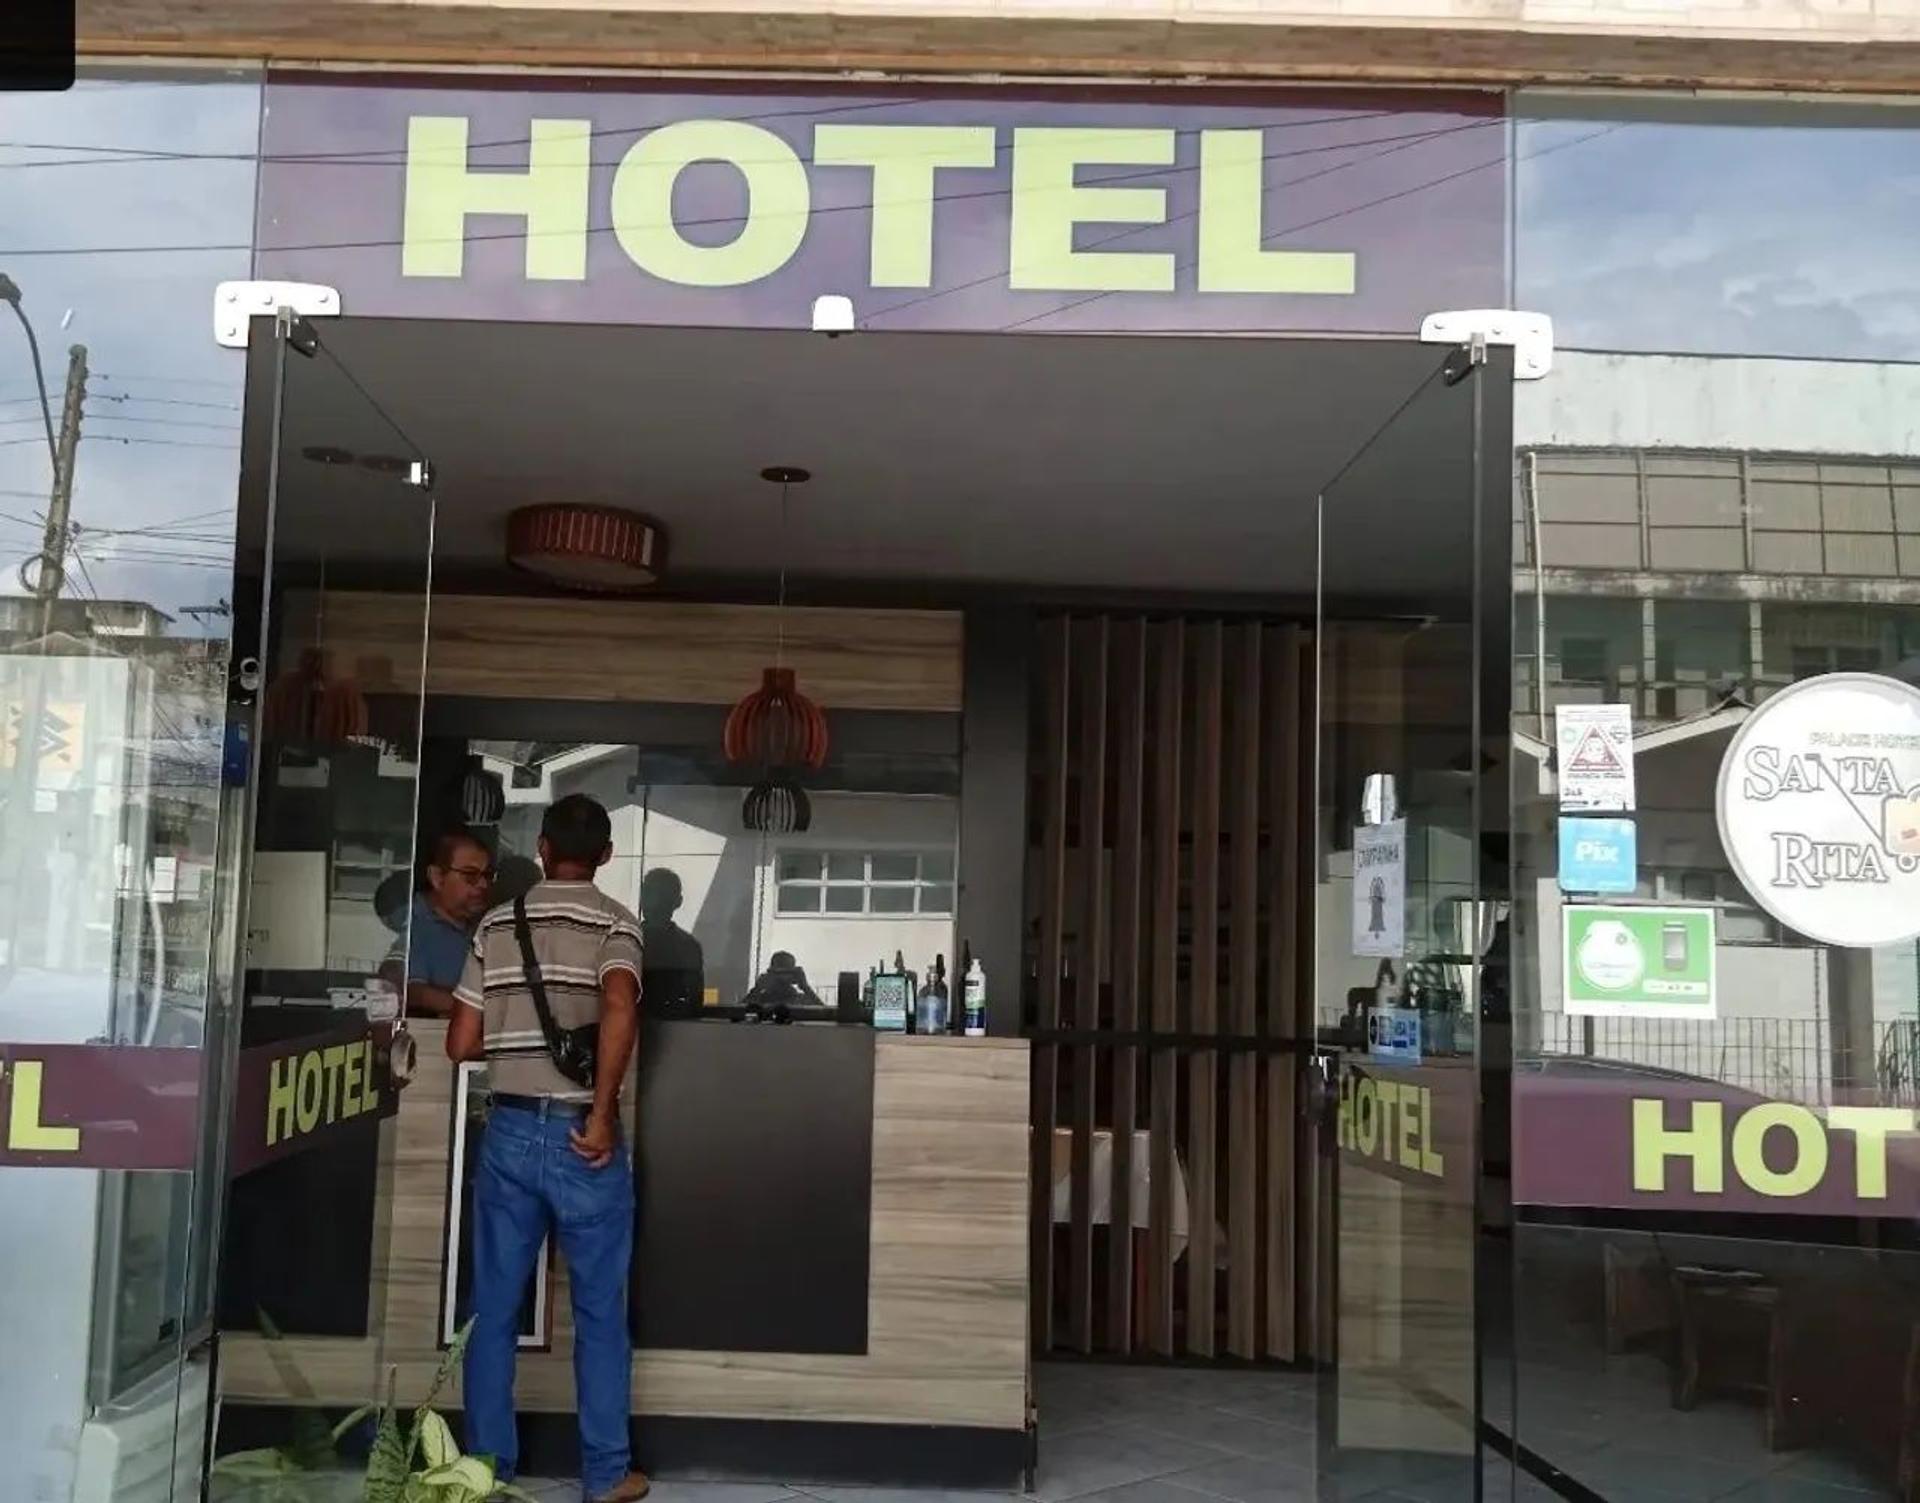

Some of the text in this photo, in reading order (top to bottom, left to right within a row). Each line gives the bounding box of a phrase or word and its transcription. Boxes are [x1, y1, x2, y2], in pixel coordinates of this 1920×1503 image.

[402, 115, 1357, 295] HOTEL
[1744, 745, 1904, 801] SANTA
[1810, 732, 1871, 747] PALACE
[1575, 840, 1619, 862] Pix
[1771, 832, 1890, 888] RITA
[0, 1060, 80, 1151] L
[266, 1039, 379, 1147] HOTEL
[1337, 1064, 1444, 1178] HOTEL
[1632, 1098, 1914, 1199] HOT
